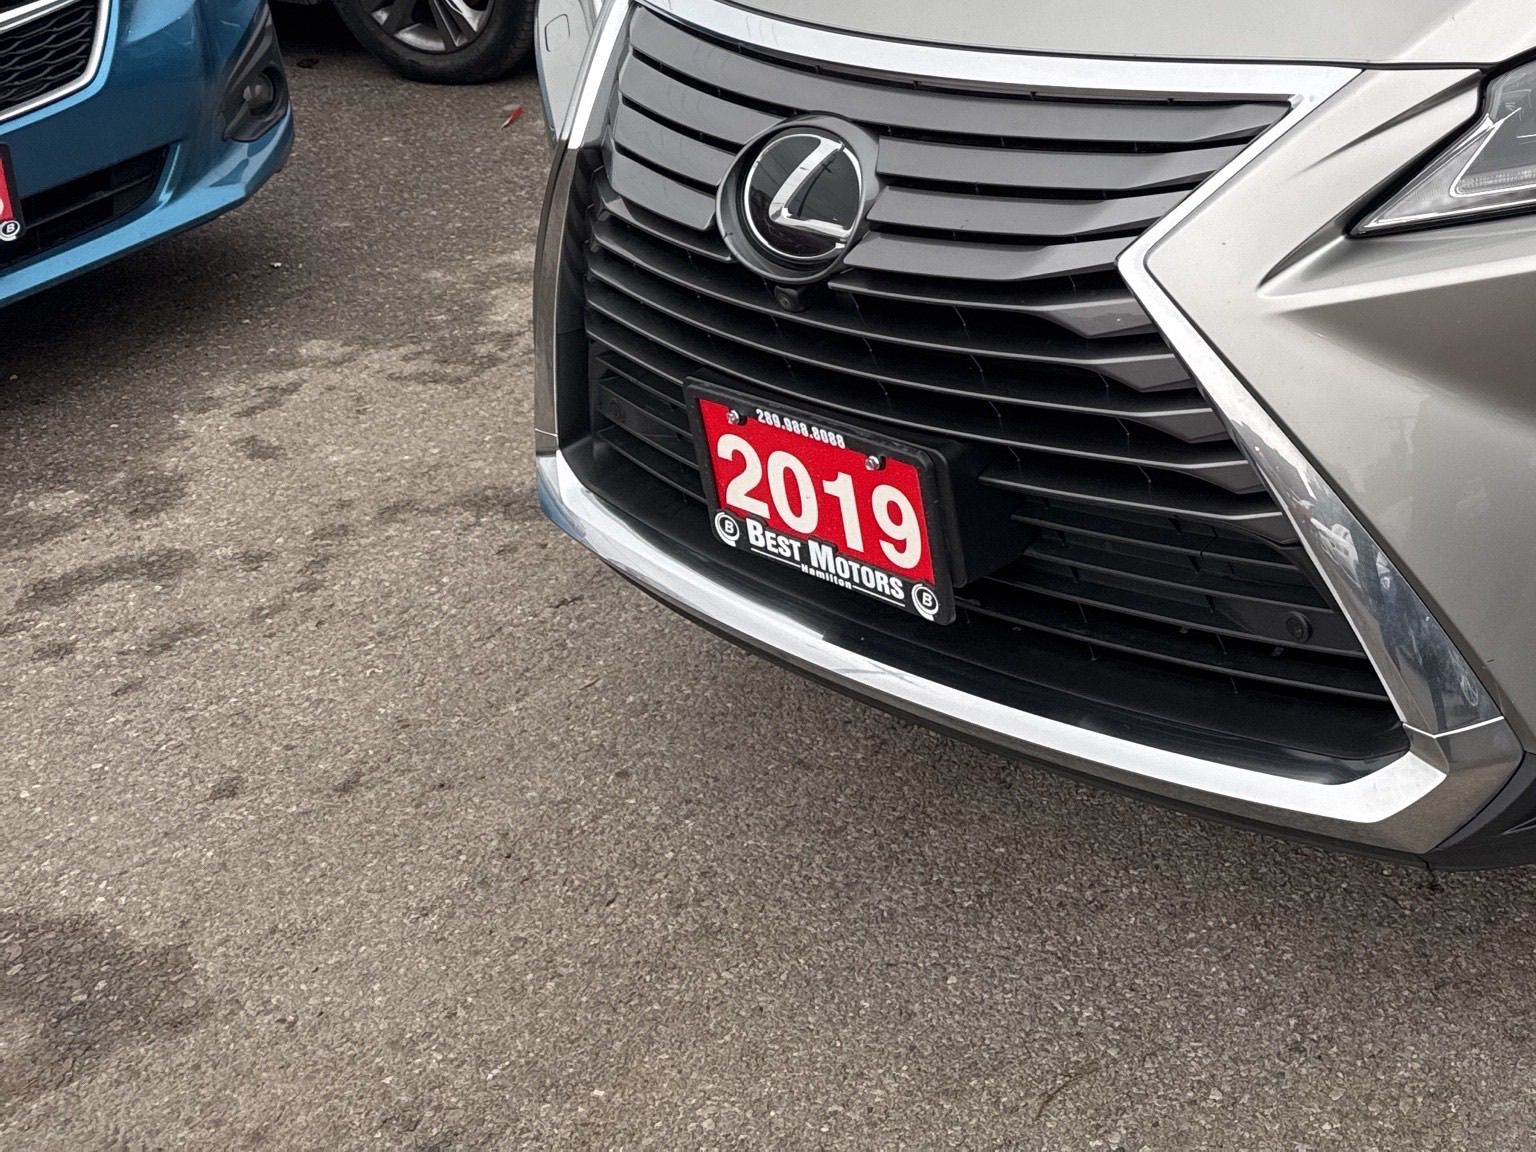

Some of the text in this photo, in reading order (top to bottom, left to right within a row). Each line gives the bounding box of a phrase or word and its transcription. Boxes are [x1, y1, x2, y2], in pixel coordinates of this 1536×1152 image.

[756, 408, 846, 449] 289.988.8088
[717, 433, 922, 570] 2019
[746, 517, 906, 601] BEST MOTORS
[800, 563, 853, 591] Hamilton
